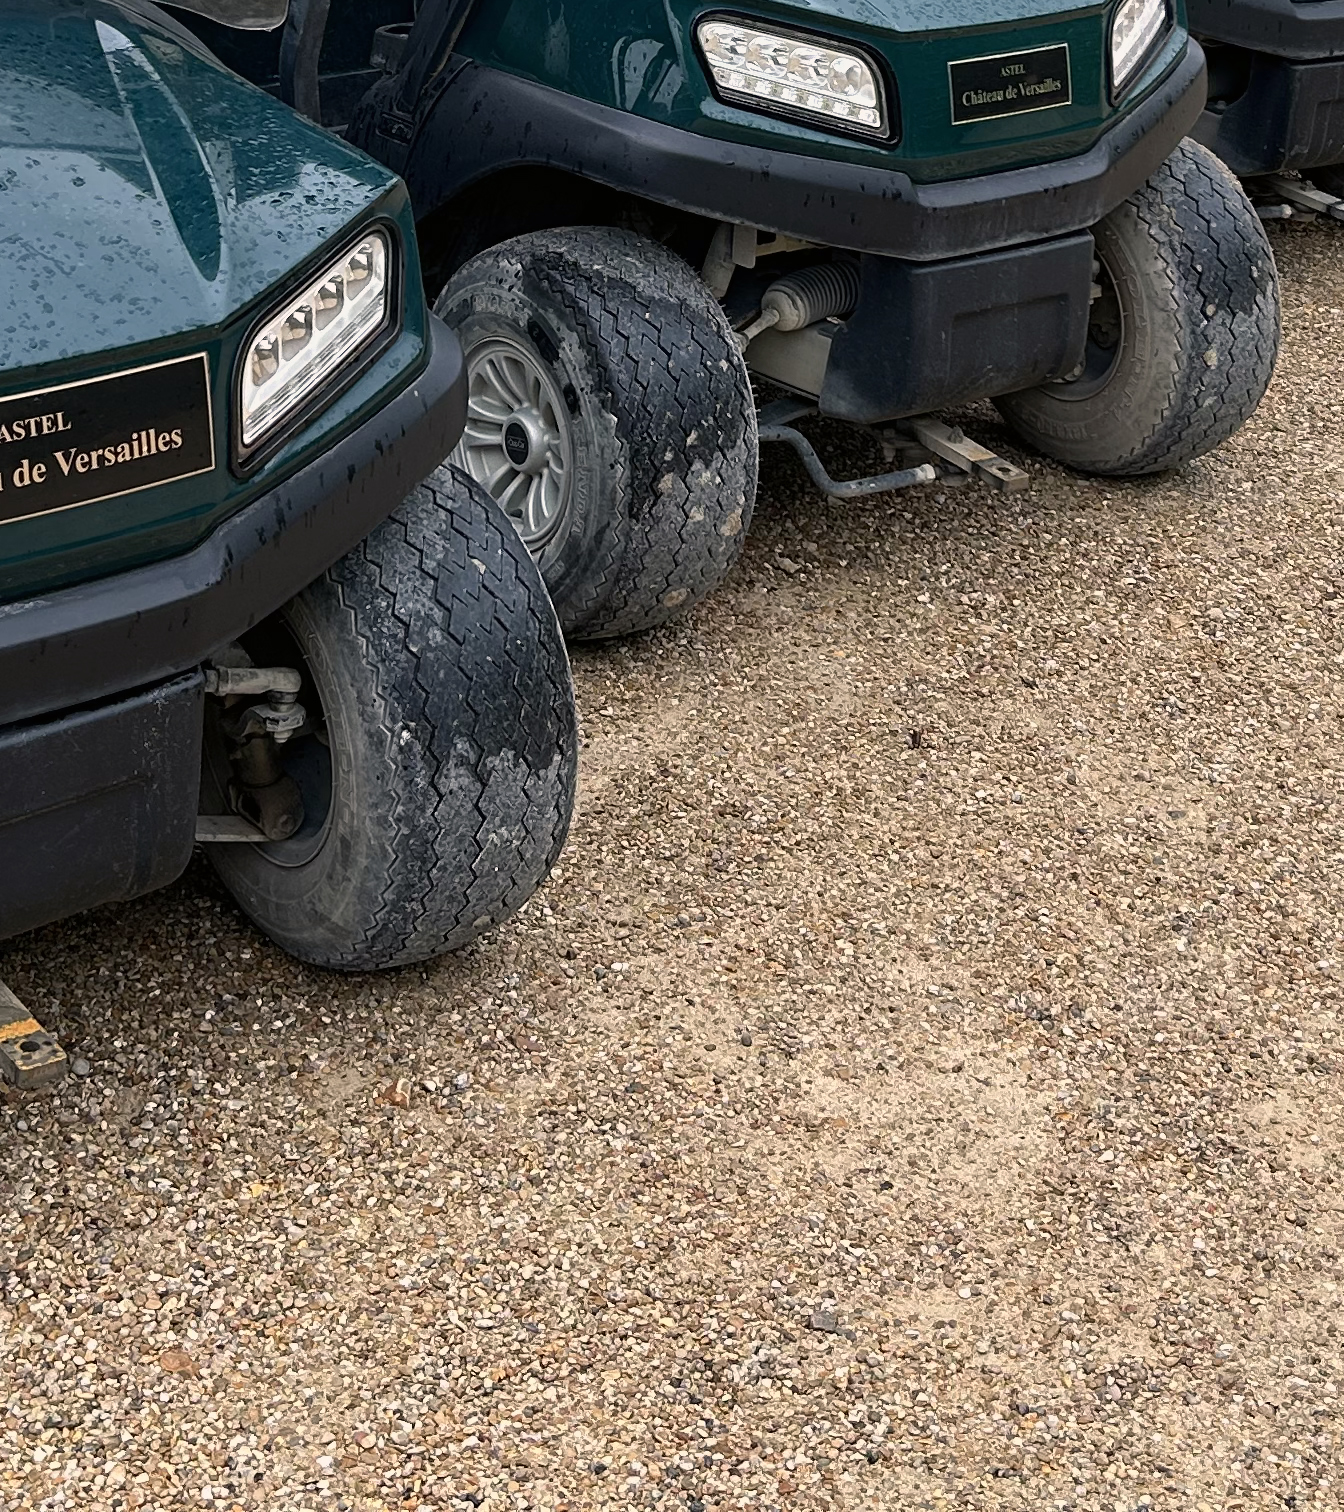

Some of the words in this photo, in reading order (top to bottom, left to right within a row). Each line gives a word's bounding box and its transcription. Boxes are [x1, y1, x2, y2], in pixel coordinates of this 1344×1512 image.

[1000, 63, 1026, 77] ASTEL
[962, 89, 1004, 106] Château
[1006, 83, 1018, 99] de
[1019, 77, 1062, 96] Versailles
[13, 459, 47, 487] de
[53, 428, 183, 477] Versailles
